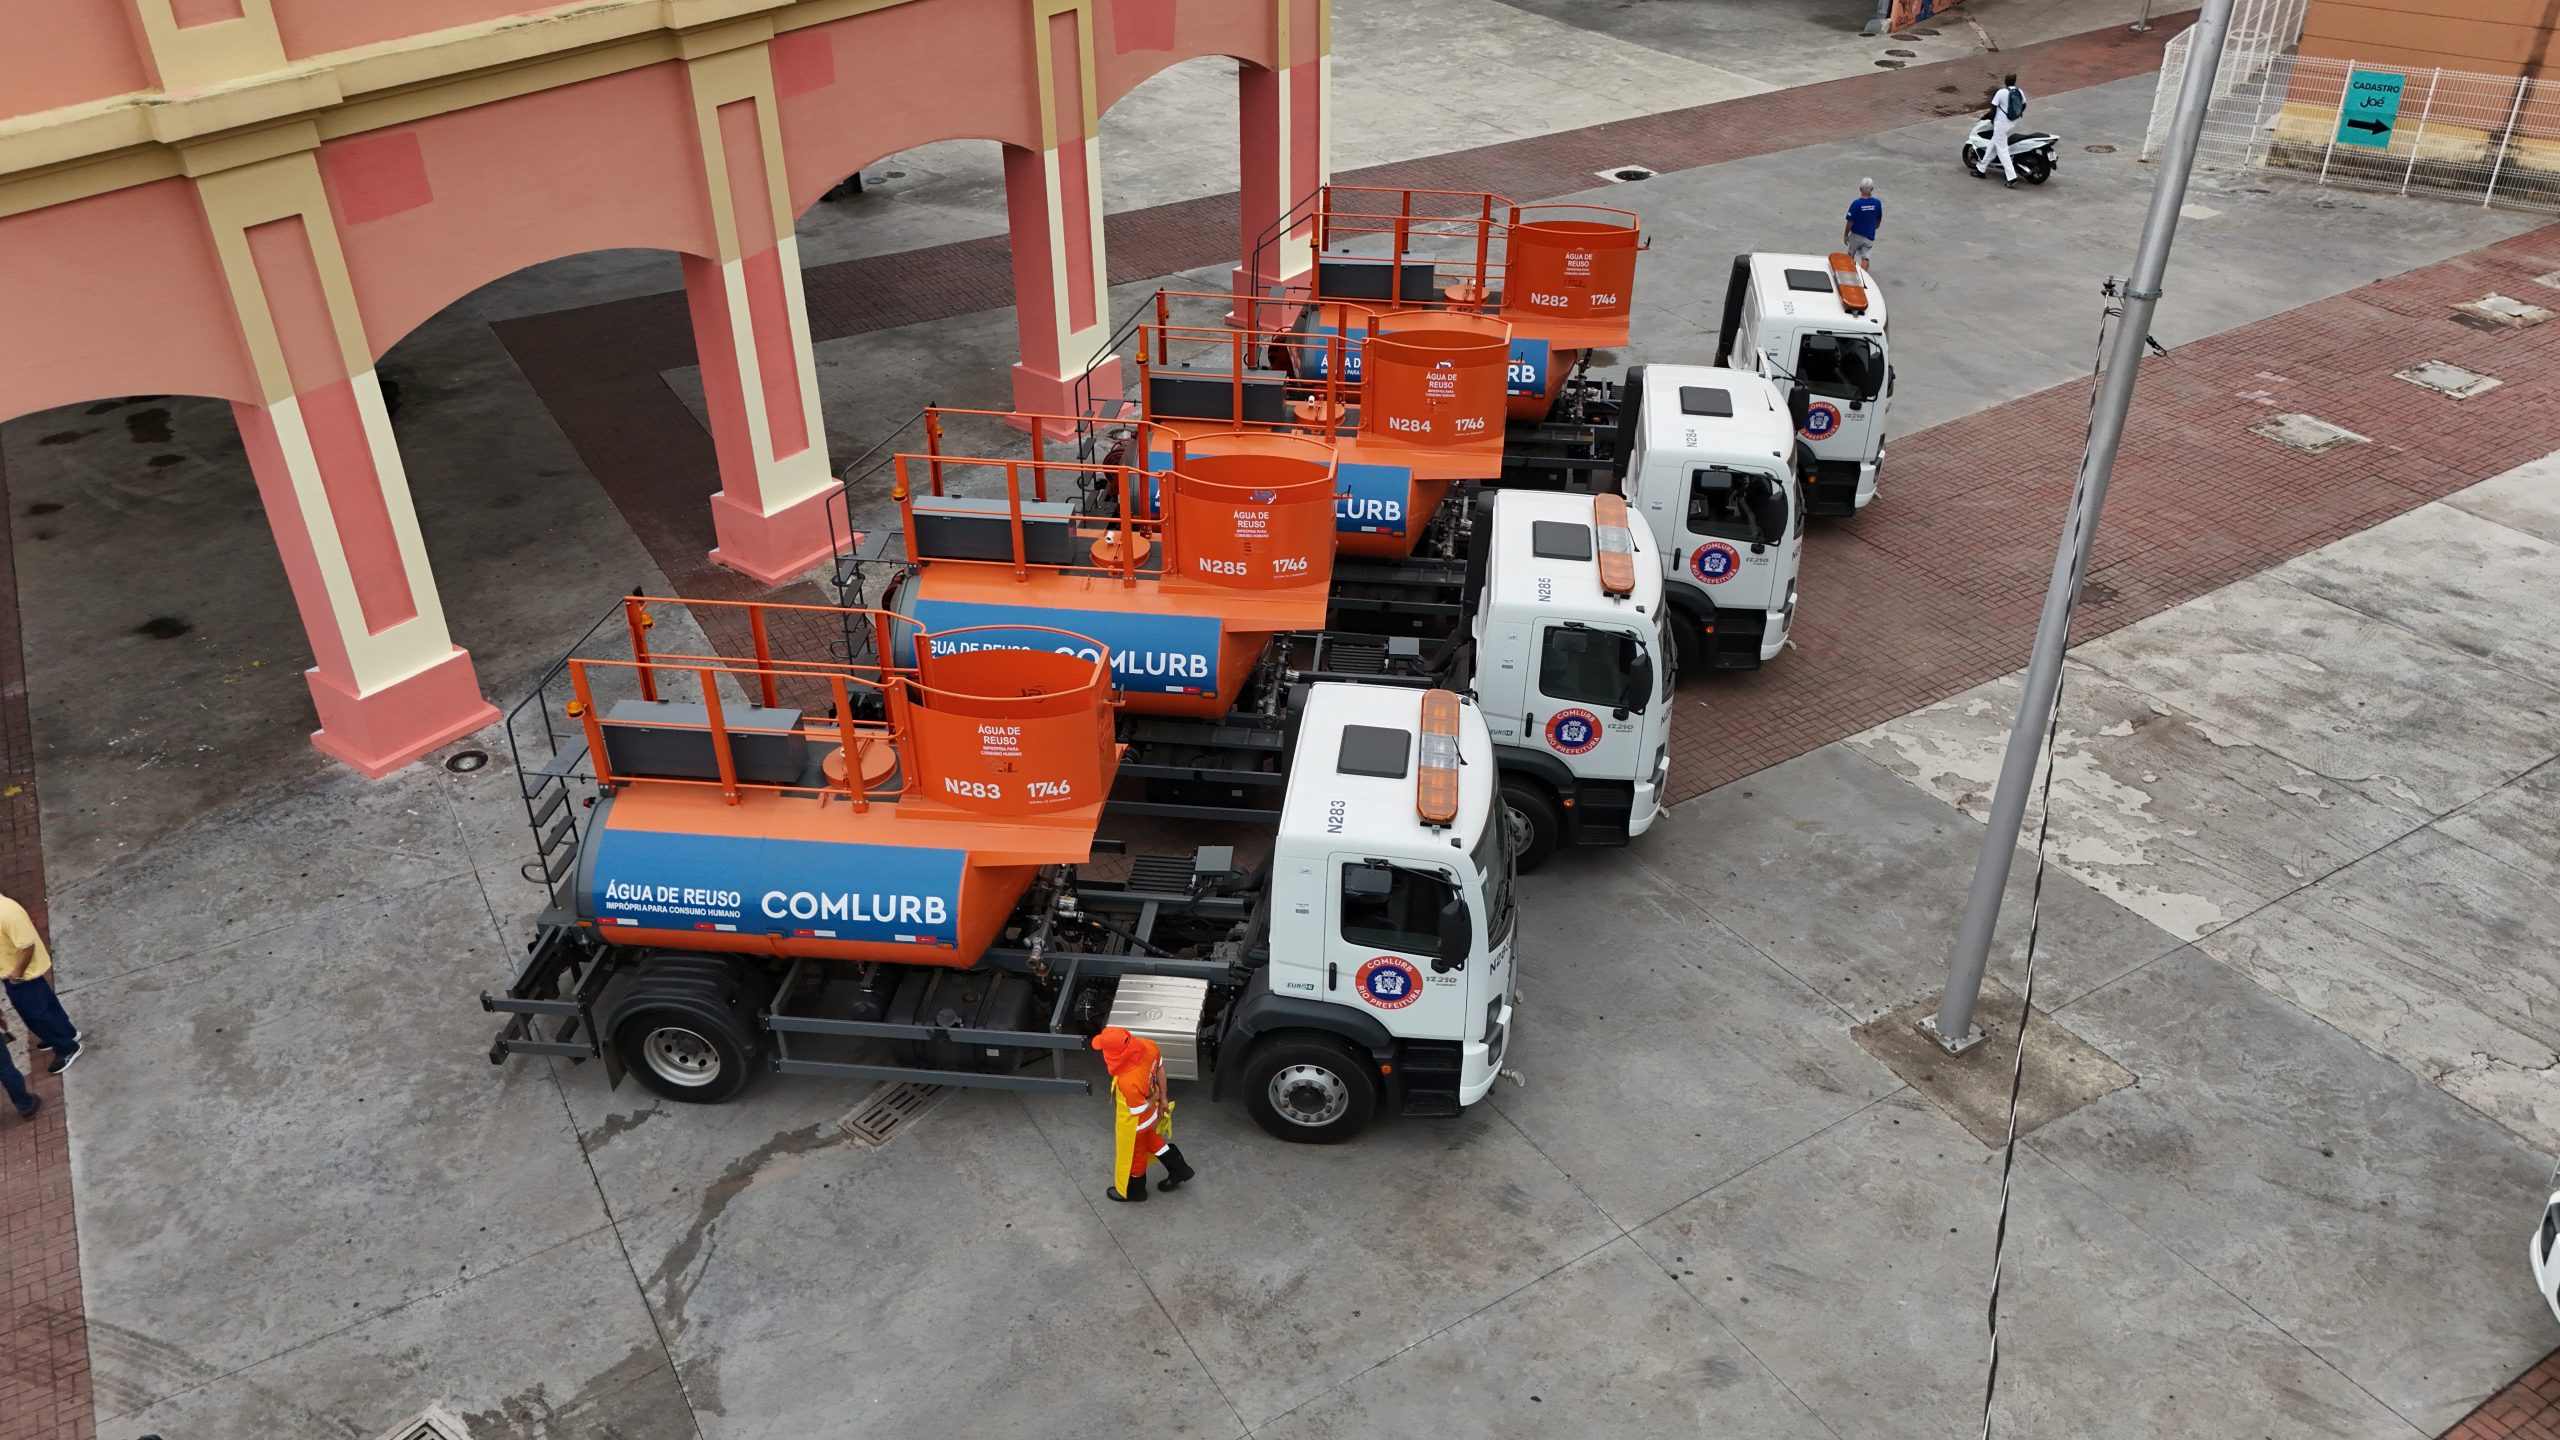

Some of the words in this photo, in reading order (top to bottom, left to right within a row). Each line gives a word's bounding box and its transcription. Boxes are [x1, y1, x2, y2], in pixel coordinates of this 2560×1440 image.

[2353, 82, 2400, 93] CADASTRO
[1565, 252, 1583, 260] ÁGUA
[1531, 292, 1568, 308] N282
[1590, 293, 1616, 305] 1746
[1426, 371, 1446, 380] ÁGUA
[1389, 416, 1431, 433] N284
[1455, 417, 1485, 431] 1746
[1686, 428, 1697, 447] N284
[1233, 509, 1257, 519] ÁGUA
[1258, 511, 1270, 520] DE
[1237, 520, 1266, 528] REUSO
[1701, 543, 1735, 555] COMLURB
[1199, 557, 1247, 576] N285
[1272, 556, 1308, 573] 1746
[1698, 568, 1738, 584] PREFEITURA
[1538, 577, 1551, 602] N285
[930, 640, 957, 654] GUA
[1557, 710, 1595, 723] COMLURB
[978, 724, 1005, 735] ÁGUA
[1007, 726, 1021, 735] DE
[983, 735, 1017, 745] REUSO
[1547, 733, 1556, 746] RIO
[1556, 737, 1600, 755] PREFEITURA
[944, 777, 1001, 799] N283
[1026, 779, 1071, 798] 1746
[1327, 800, 1346, 834] N283
[605, 879, 653, 901] ÁGUA
[657, 886, 679, 903] DE
[684, 888, 741, 907] REUSO
[669, 906, 706, 916] CONSUMO
[708, 909, 741, 918] HUMANO
[761, 890, 947, 924] COMLURB
[1367, 958, 1413, 972] COMLURB
[1358, 985, 1370, 999] RIO
[1370, 989, 1421, 1009] PREFEITURA
